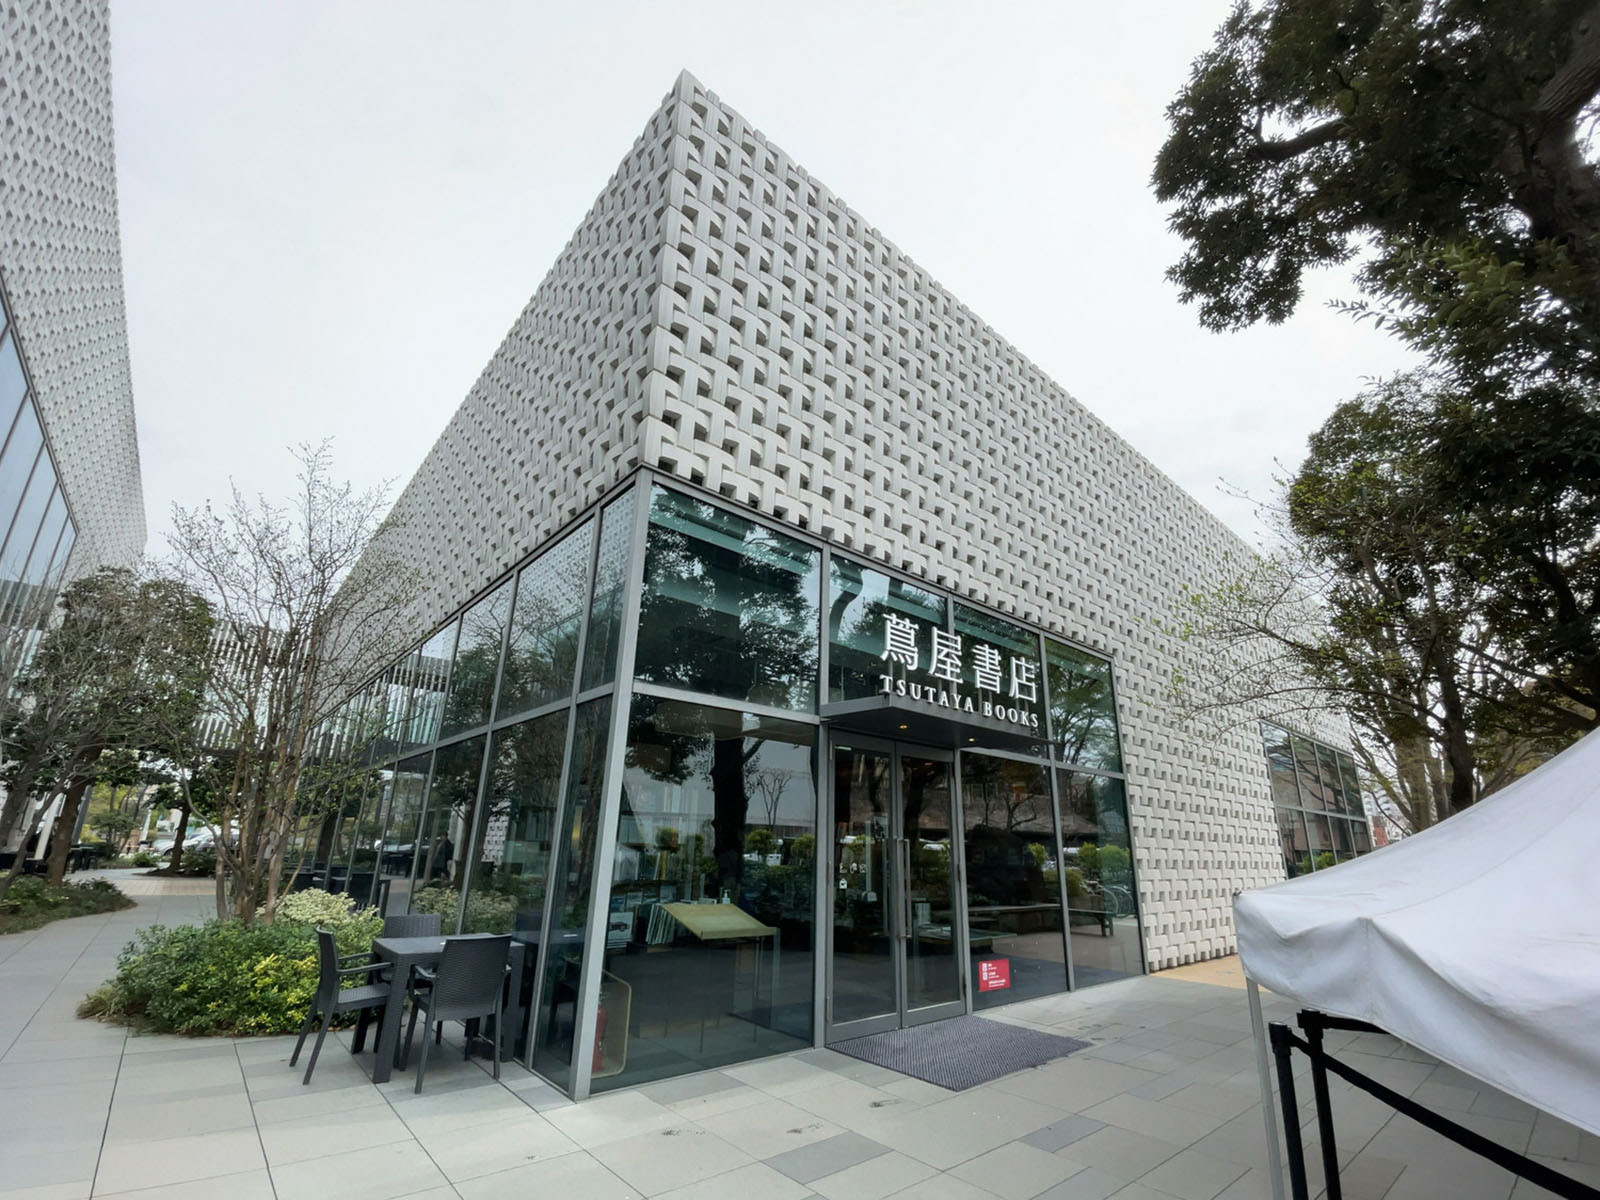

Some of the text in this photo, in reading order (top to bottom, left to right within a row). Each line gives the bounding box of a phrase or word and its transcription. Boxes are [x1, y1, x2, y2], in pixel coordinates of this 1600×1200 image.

[880, 613, 1037, 703] 蔦屋書店
[879, 674, 1039, 728] TSUTAYA BOOKS
